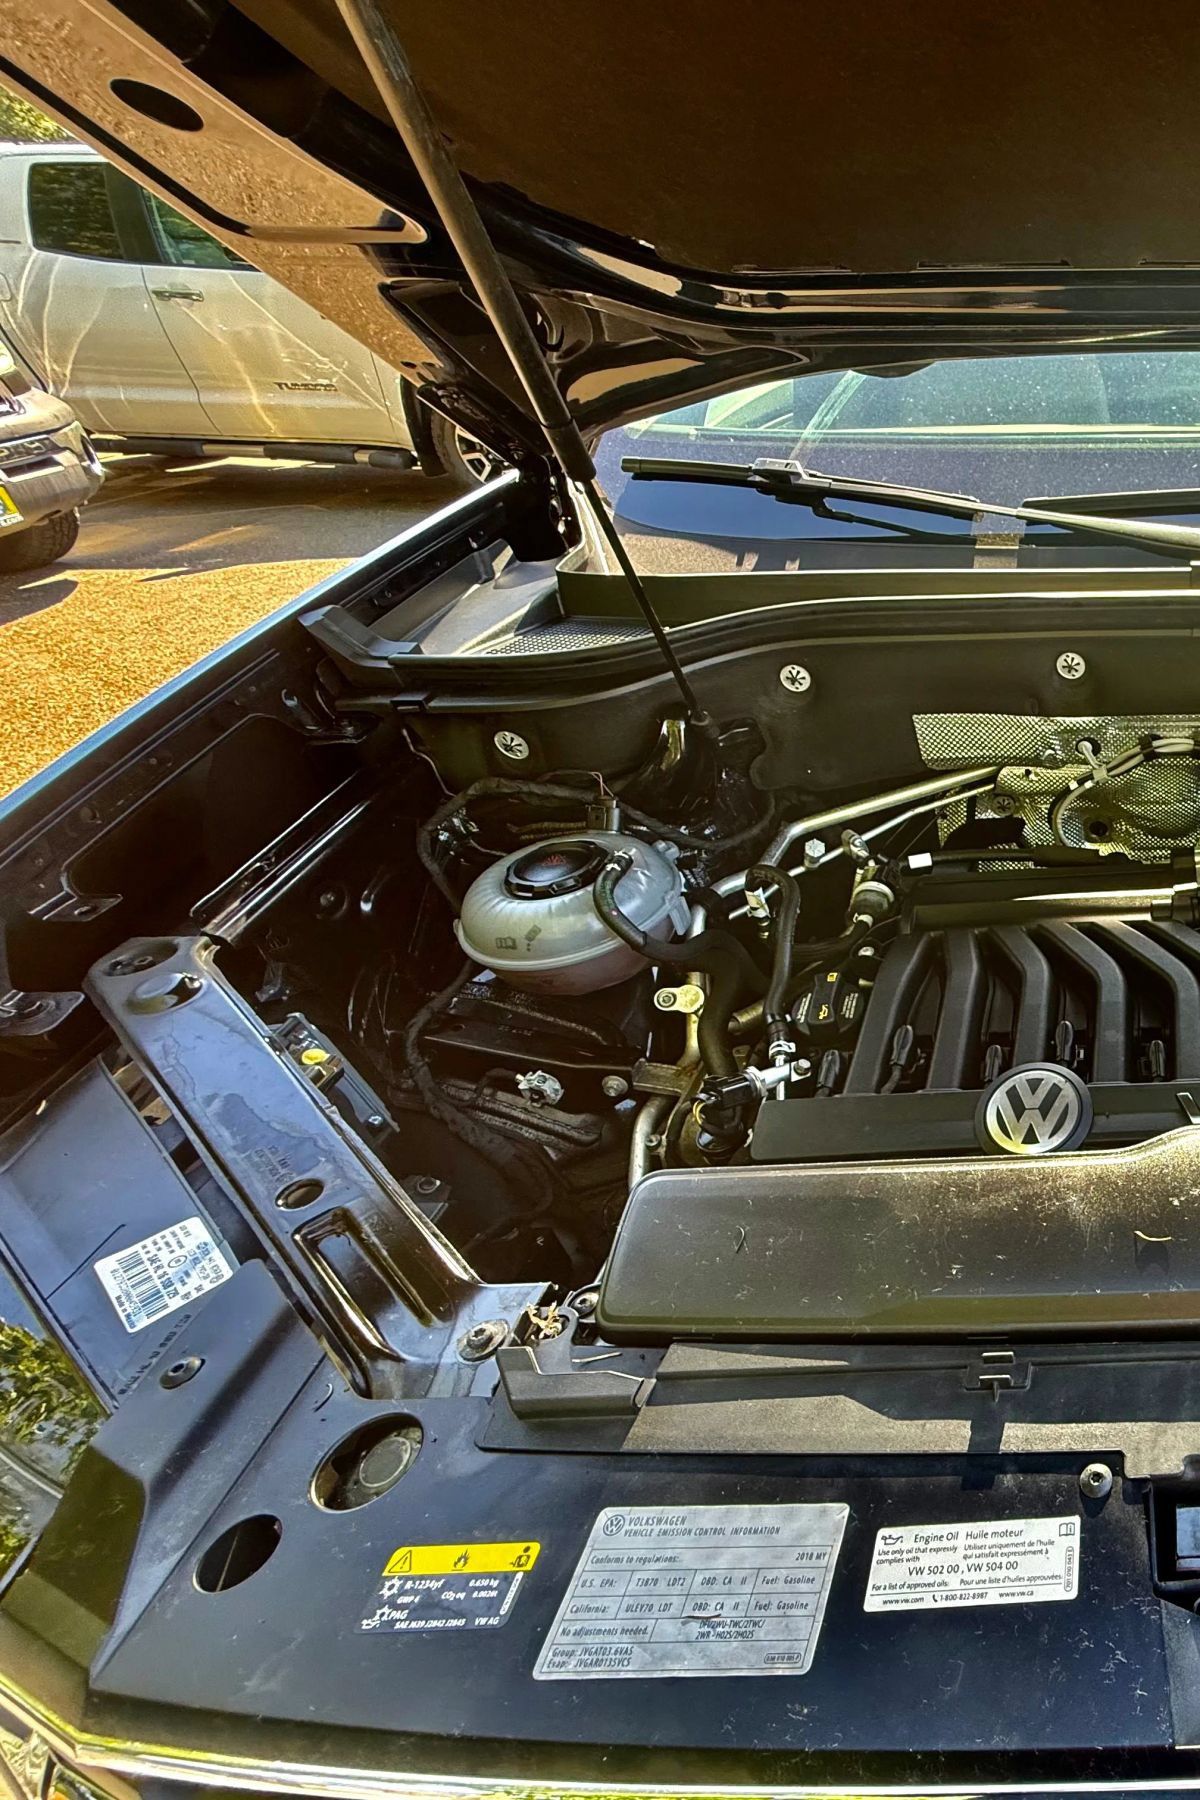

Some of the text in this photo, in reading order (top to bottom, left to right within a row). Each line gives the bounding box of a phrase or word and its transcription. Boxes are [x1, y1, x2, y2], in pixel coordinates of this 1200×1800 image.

[628, 1515, 687, 1526] VOLKSWAGEN
[623, 1526, 780, 1537] VEHICLE EMISSION CONTROL INFORMATION
[913, 1529, 1023, 1545] Engine Oil Huile moteur
[963, 1543, 987, 1551] Utilisez
[987, 1540, 1026, 1550] uniquement
[1036, 1538, 1055, 1546] l'huile
[795, 1551, 827, 1561] 2018 MY
[890, 1548, 904, 1557] only
[928, 1544, 957, 1554] expressly
[962, 1552, 973, 1560] qui
[974, 1550, 999, 1559] satisfait
[999, 1548, 1043, 1558] expressément
[590, 1554, 679, 1565] Conforms to regulations:
[876, 1557, 904, 1565] complies
[908, 1560, 1018, 1576] VW 502 00 VW 504 00
[404, 1578, 445, 1590] R-1234yf
[599, 1578, 617, 1588] EPA:
[666, 1576, 686, 1587] LDT2
[722, 1576, 732, 1585] CA
[740, 1576, 747, 1585] II
[761, 1575, 815, 1585] Fuel: Gasoline
[871, 1583, 882, 1591] For
[888, 1582, 897, 1590] list
[898, 1581, 906, 1589] of
[906, 1580, 936, 1590] approved
[959, 1578, 974, 1586] Pour
[987, 1576, 1001, 1584] liste
[940, 1591, 988, 1601] 1-800-822-8987
[570, 1604, 609, 1614] California:
[624, 1602, 673, 1613] ULEV70 LDT
[692, 1601, 739, 1611] OBD: CA II
[753, 1600, 808, 1611] Fuel: Gasoline
[388, 1609, 408, 1619] PAG
[474, 1617, 488, 1625] VW
[487, 1616, 499, 1624] AG
[560, 1625, 648, 1638] No adjustments needed.
[552, 1647, 578, 1657] Group:
[546, 1658, 569, 1669] Evap:
